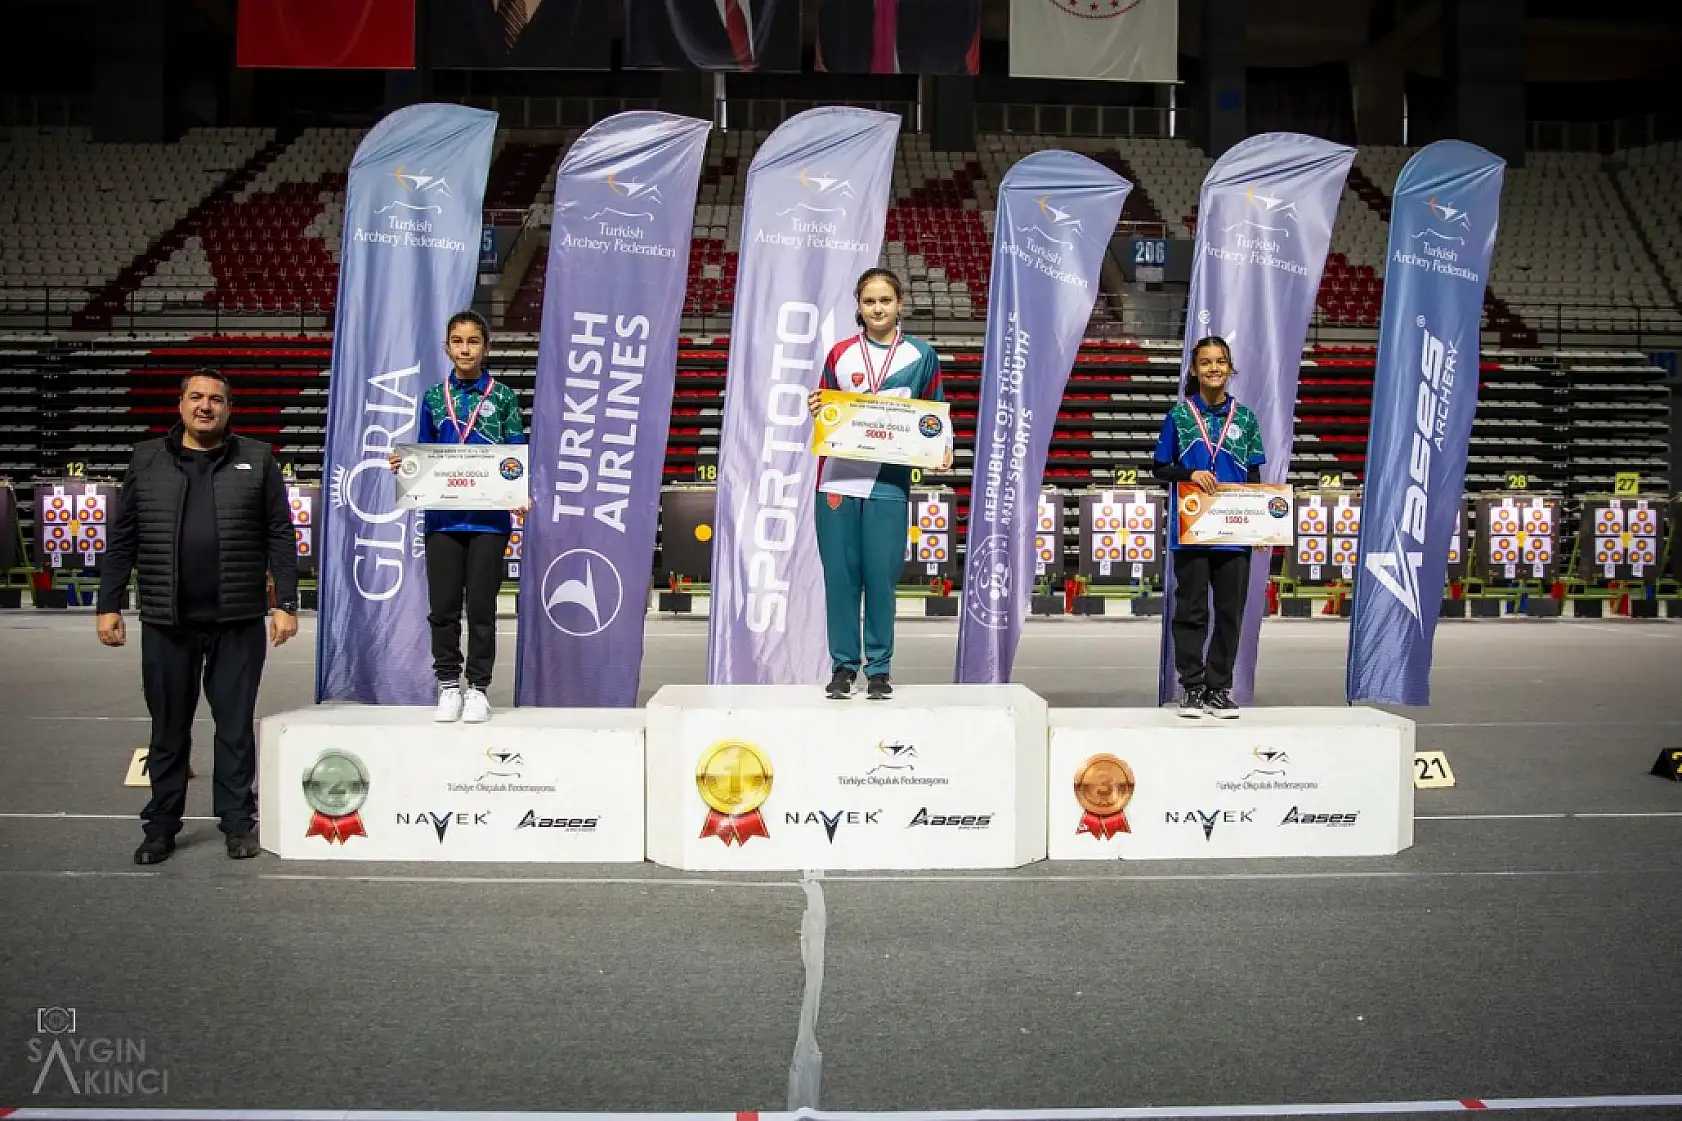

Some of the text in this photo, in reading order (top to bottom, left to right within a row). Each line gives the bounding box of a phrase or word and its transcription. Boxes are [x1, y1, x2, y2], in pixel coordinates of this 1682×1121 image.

[389, 216, 432, 232] Turkish
[599, 222, 644, 239] Turkish
[792, 218, 836, 235] Turkish
[354, 228, 465, 252] Archery Federation
[562, 233, 676, 257] Archery Federation
[755, 229, 869, 252] Archery Federation
[1236, 233, 1280, 253] Turkish
[1424, 240, 1458, 261] Turkish
[1135, 241, 1165, 263] 206
[1393, 250, 1479, 281] Archery Federation
[1010, 330, 1030, 395] YOUTH
[1434, 340, 1459, 452] ARCHERY
[552, 311, 608, 523] TURKISH
[593, 314, 650, 533] AIRLINES
[1007, 408, 1033, 482] SPORTS
[66, 463, 84, 477] 12
[984, 431, 1007, 521] REPUBLIC
[996, 399, 1010, 425] OF
[349, 360, 421, 600] GLORIA
[698, 465, 717, 480] 18
[1117, 470, 1137, 485] 22
[1321, 474, 1341, 487] 24
[1618, 478, 1635, 491] 27
[1414, 757, 1447, 780] 21
[838, 775, 866, 787] Türkiye
[900, 775, 949, 787] Federasyonu
[396, 811, 488, 845] NAVEK
[786, 810, 879, 845] NAVEK
[1165, 809, 1253, 842] NAVEK
